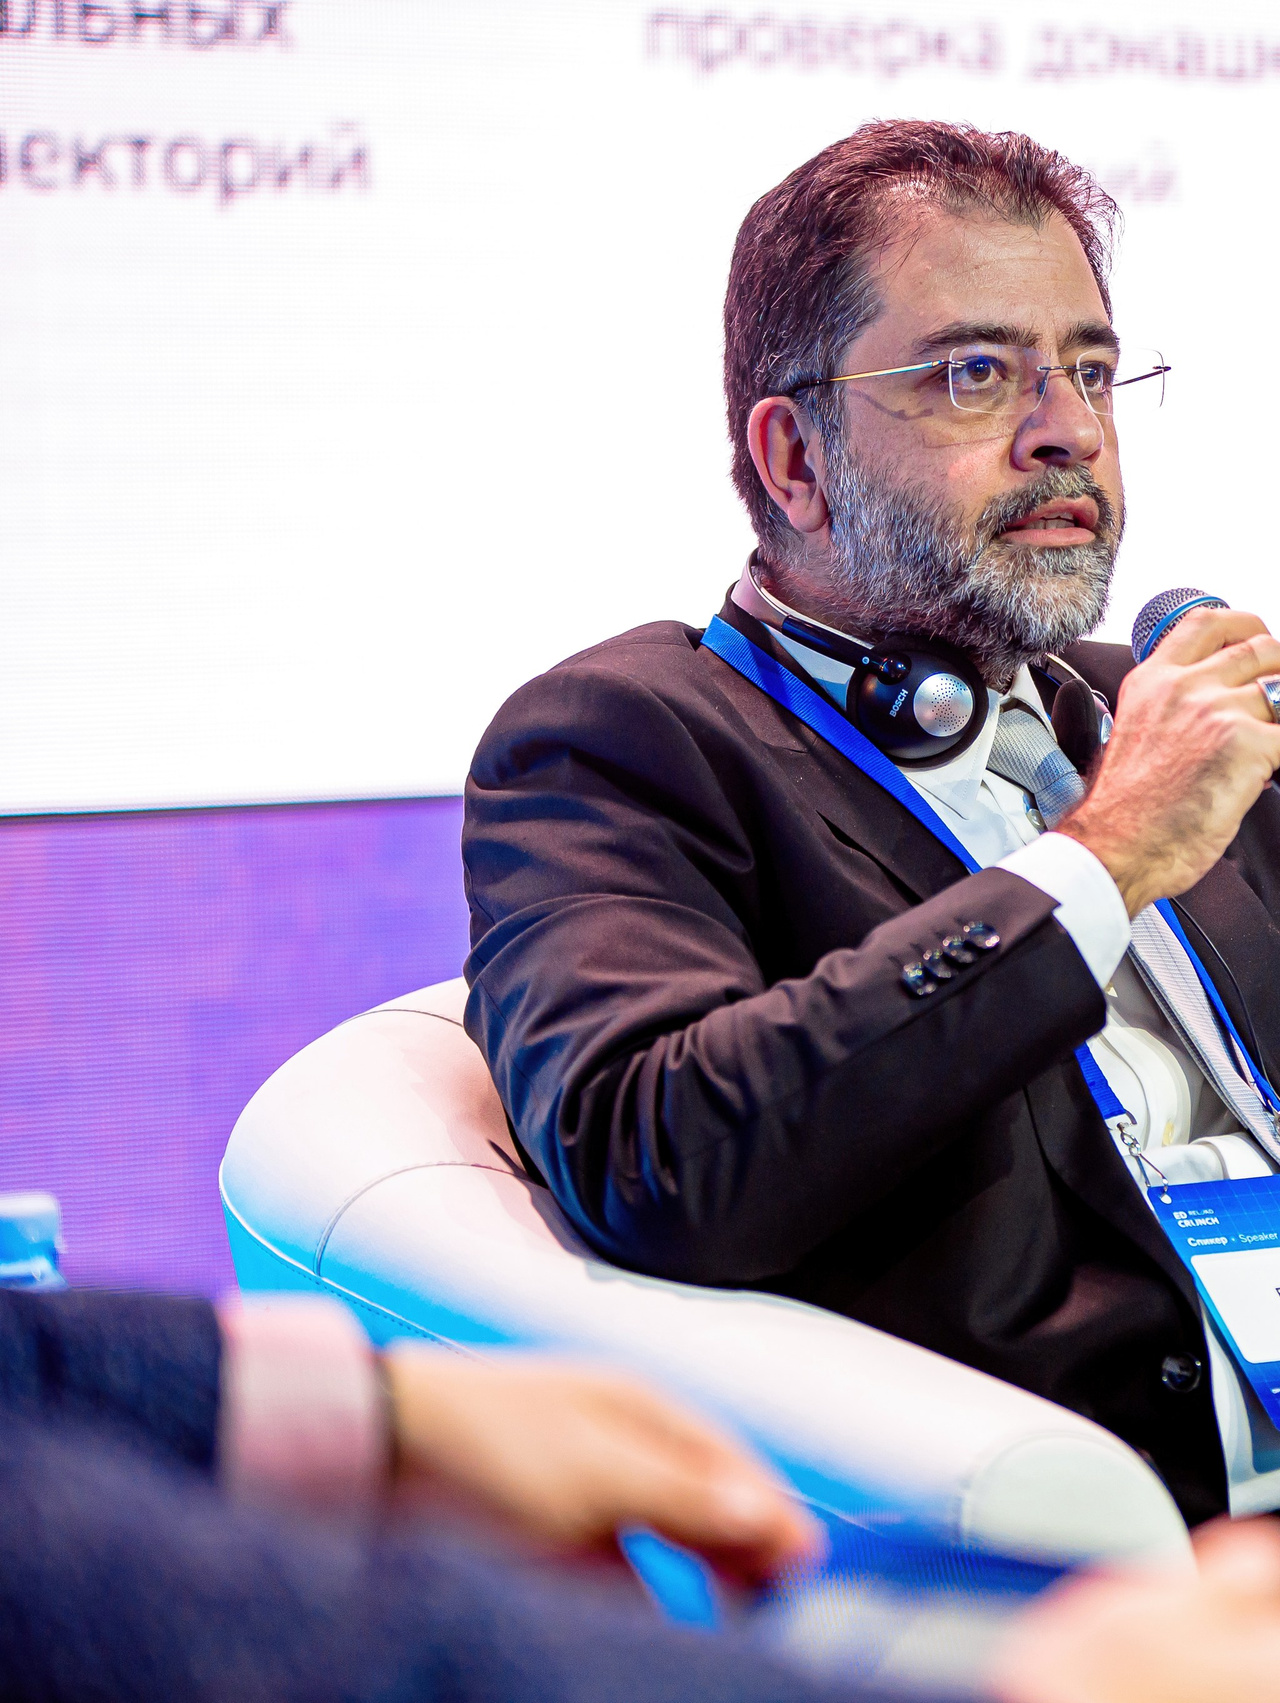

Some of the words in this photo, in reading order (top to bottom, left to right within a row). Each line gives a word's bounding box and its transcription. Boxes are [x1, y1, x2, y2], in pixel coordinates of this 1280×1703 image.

[0, 0, 296, 50] льных
[641, 8, 1003, 82] проверка
[0, 116, 374, 212] екторий
[889, 688, 909, 718] BOSCH
[1173, 1211, 1188, 1220] ED
[1178, 1217, 1220, 1228] CRUNCH
[1187, 1236, 1228, 1247] Спикер
[1239, 1232, 1278, 1244] Speaker
